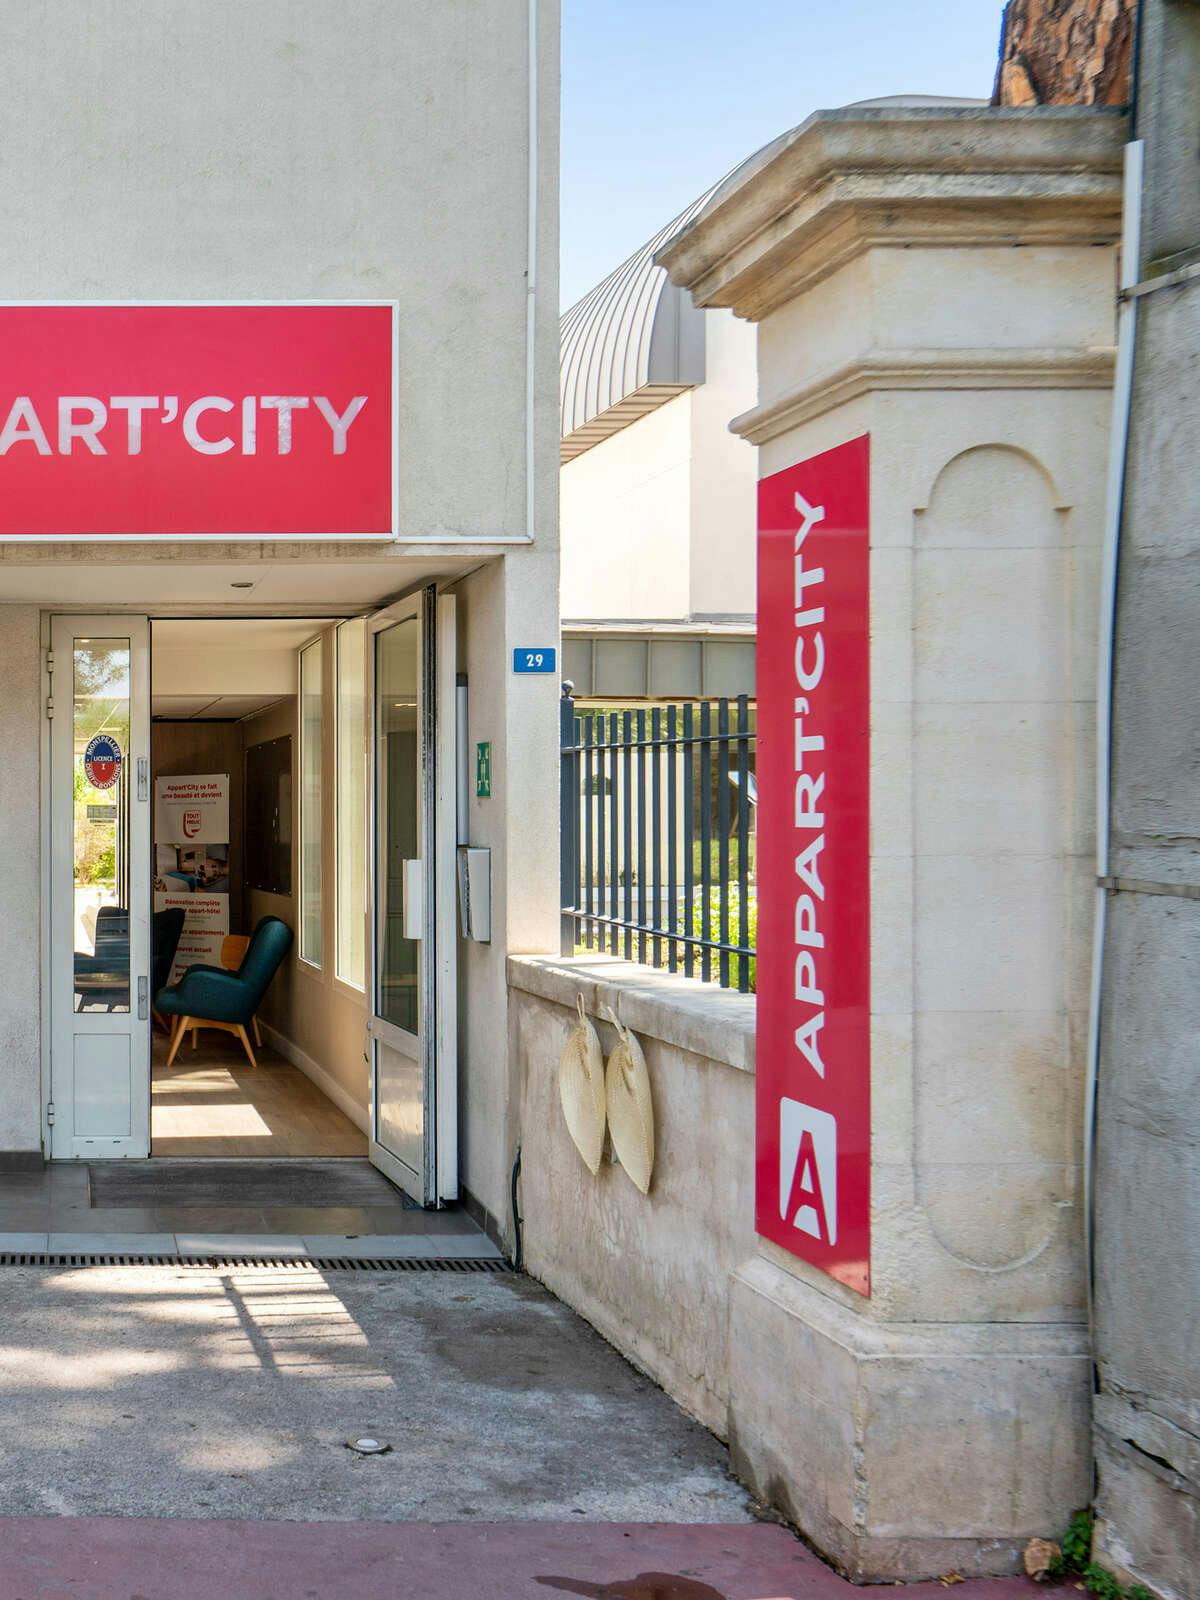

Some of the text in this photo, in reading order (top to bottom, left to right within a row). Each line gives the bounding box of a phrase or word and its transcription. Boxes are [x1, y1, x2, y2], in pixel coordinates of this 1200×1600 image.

[526, 654, 543, 667] 29
[87, 736, 121, 758] MONTPELLIER
[789, 1129, 834, 1246] A
